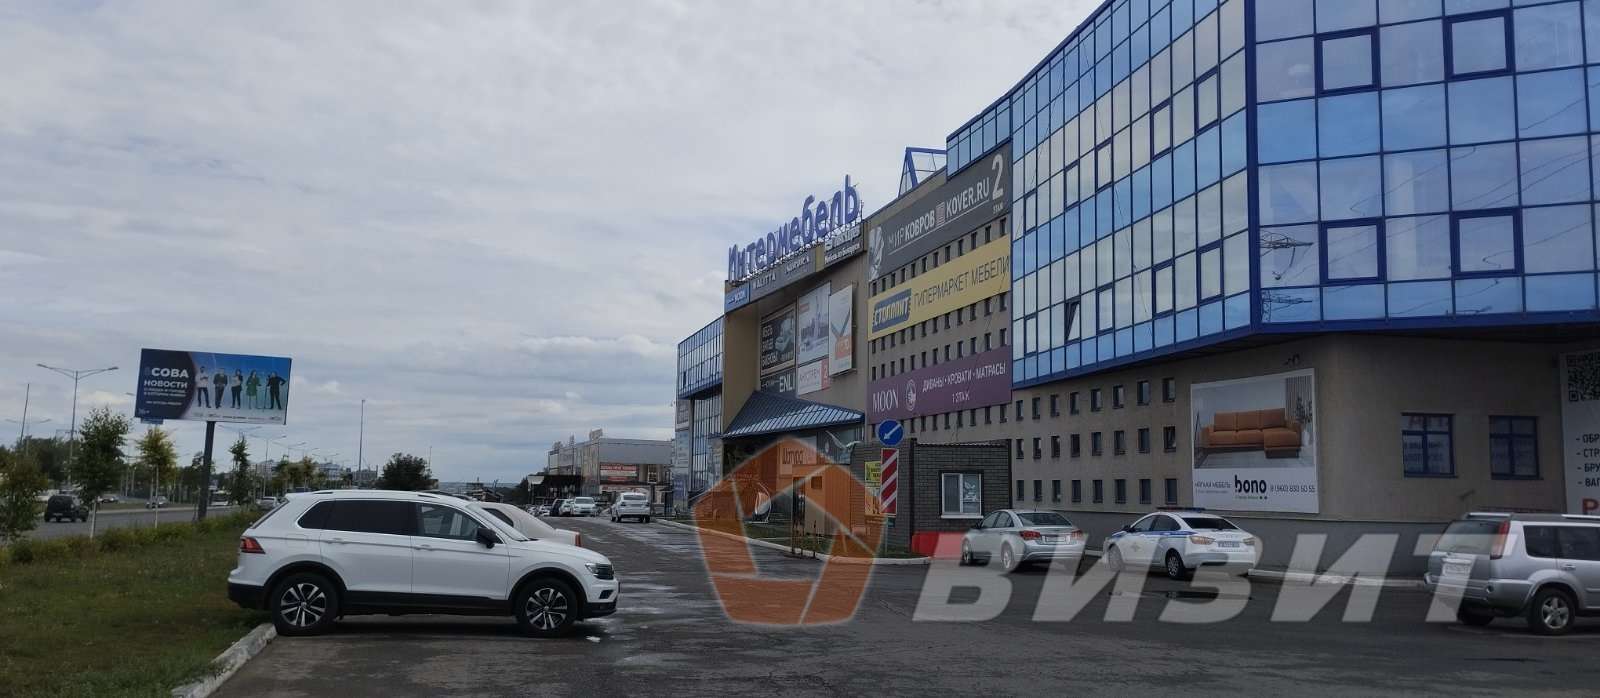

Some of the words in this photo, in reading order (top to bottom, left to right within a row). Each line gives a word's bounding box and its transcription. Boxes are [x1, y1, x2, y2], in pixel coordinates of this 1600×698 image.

[992, 153, 1004, 200] 2
[905, 210, 935, 241] КОВРОВ
[946, 177, 990, 216] KOVER.RU
[914, 272, 968, 310] ГИПЕРМАРКЕТ
[971, 256, 1009, 286] МЕБЕЛИ
[144, 380, 188, 389] НОВОСТИ
[922, 376, 944, 393] ДИВАНЫ
[947, 369, 972, 385] КРОВАТИ
[976, 362, 1006, 378] МАТРАСЫ
[872, 388, 899, 413] MOON
[1235, 474, 1267, 493] bono
